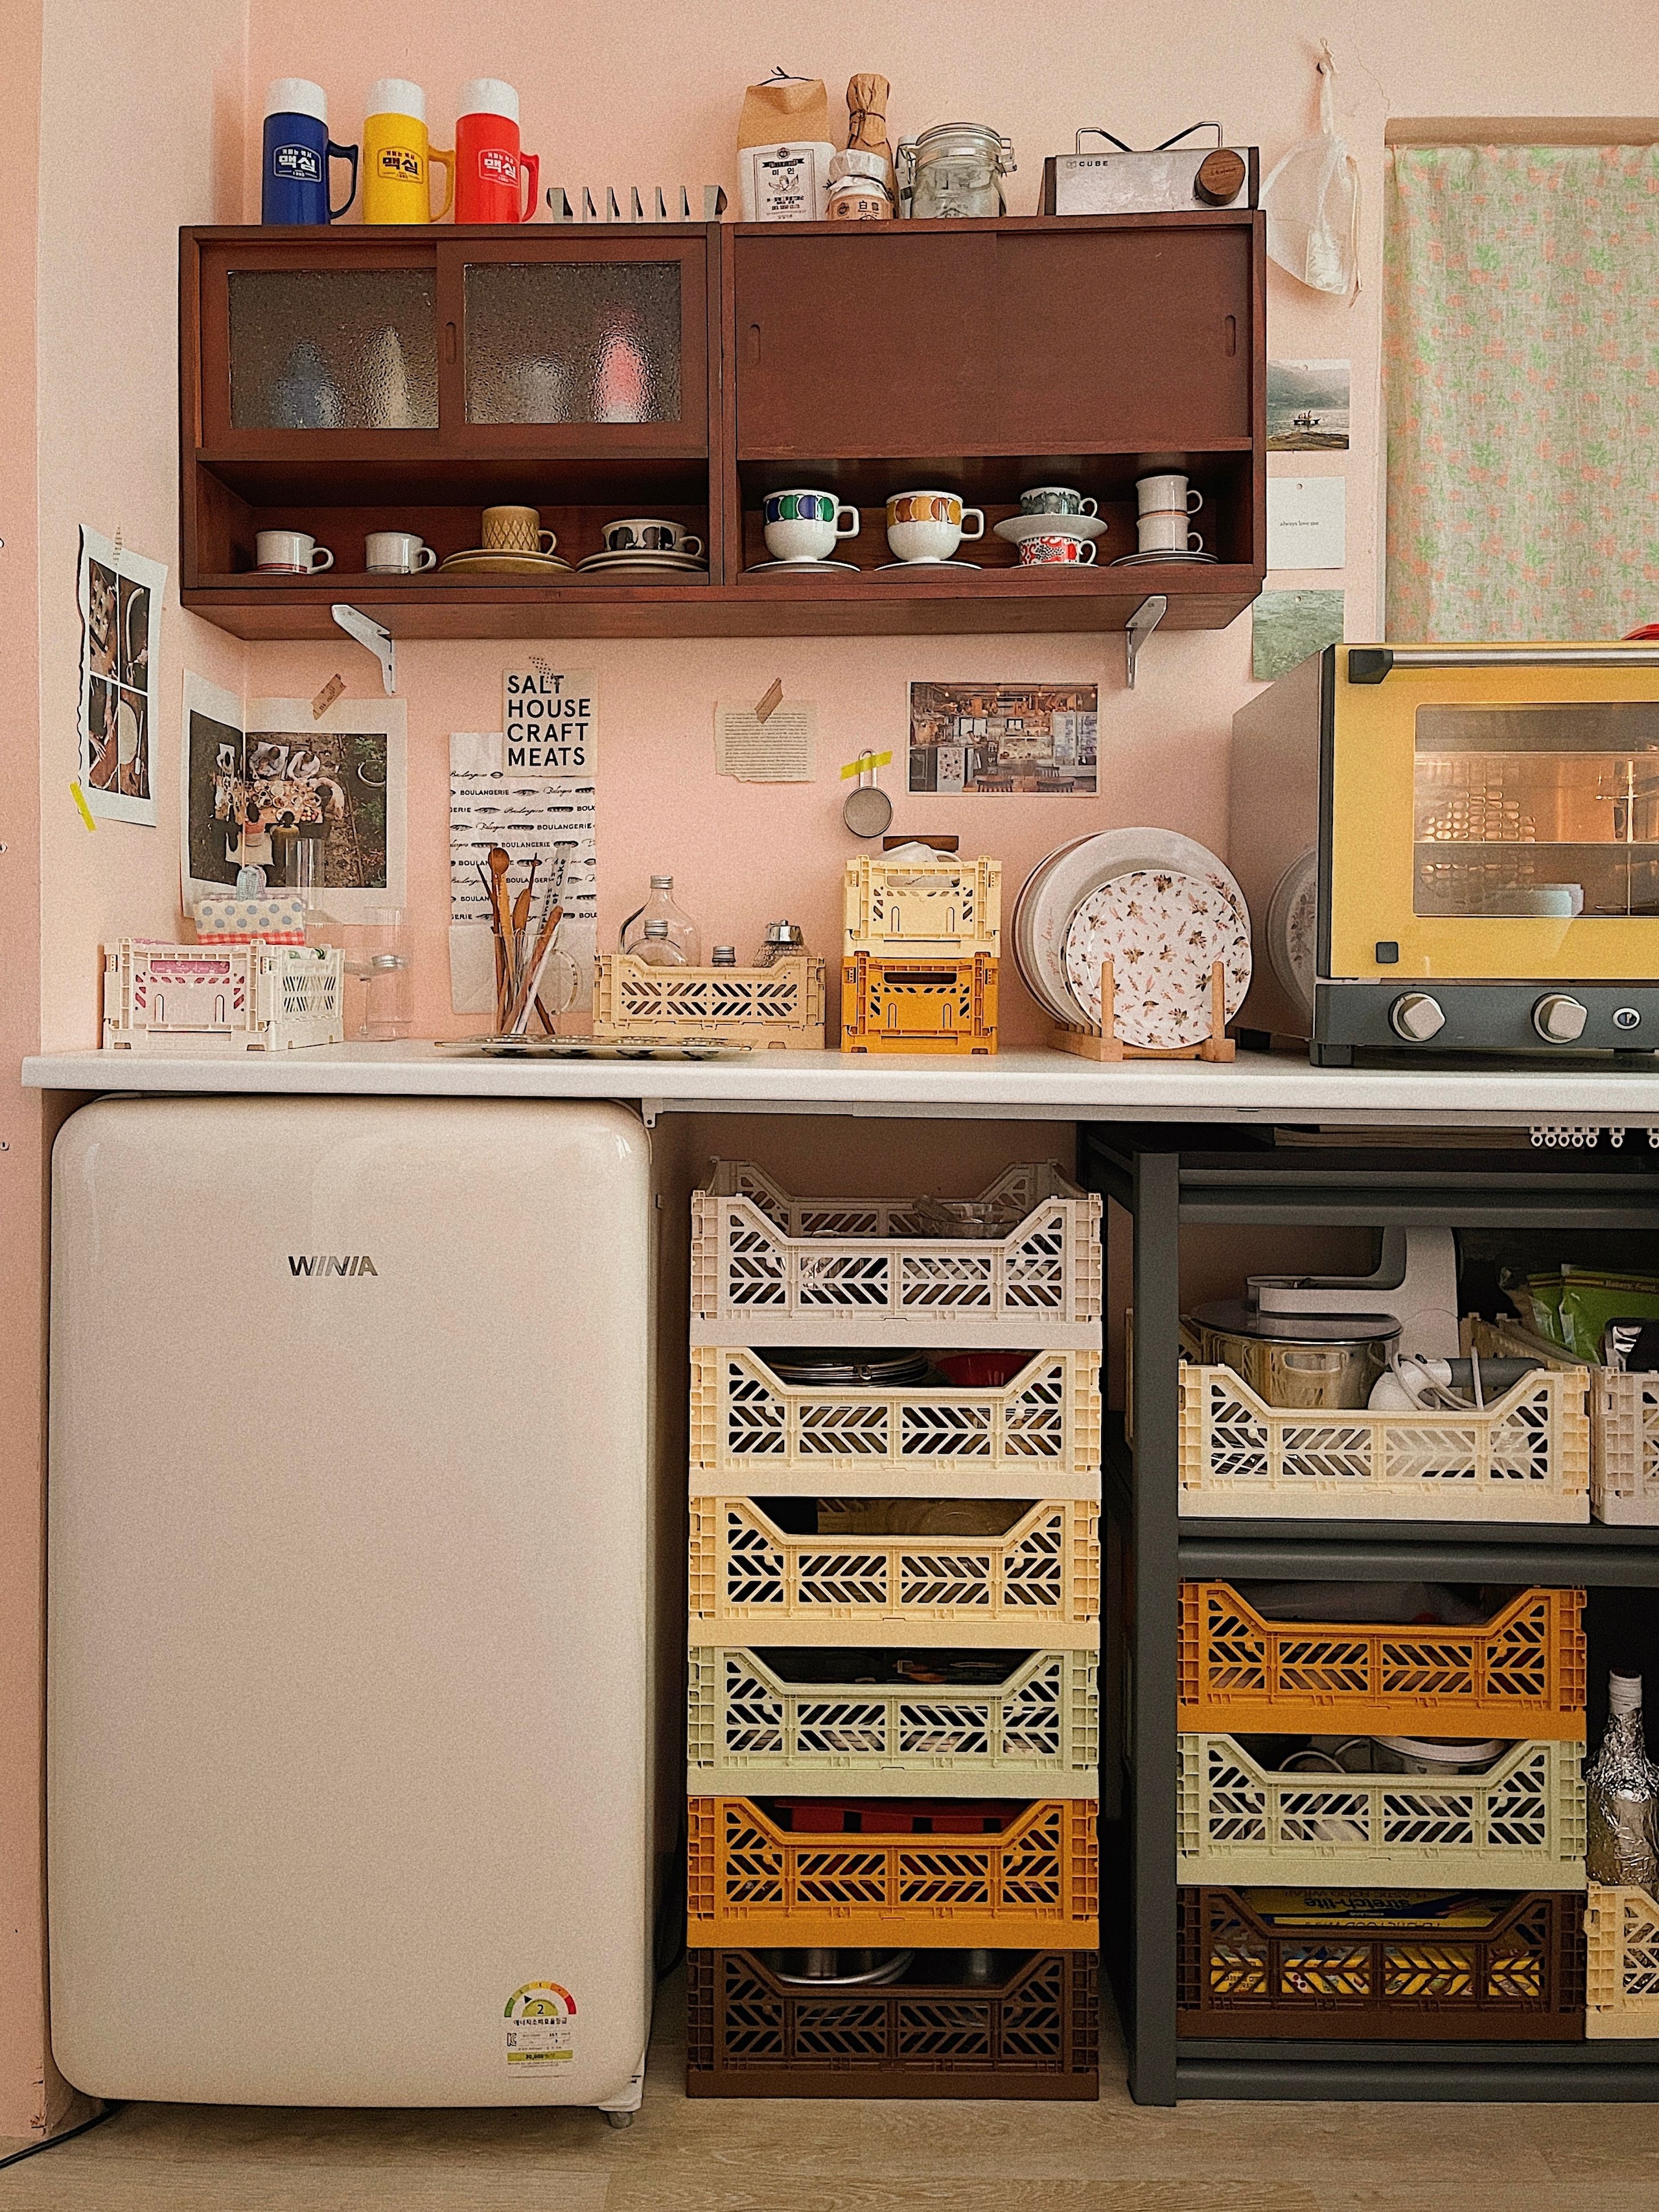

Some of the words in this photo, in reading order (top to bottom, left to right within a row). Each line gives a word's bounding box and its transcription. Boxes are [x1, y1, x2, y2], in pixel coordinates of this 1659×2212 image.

[279, 155, 317, 174] 맥심
[382, 157, 419, 175] 맥심
[484, 158, 517, 180] 맥심
[507, 675, 564, 694] SALT
[508, 698, 591, 718] HOUSE
[507, 723, 589, 742] CRAFT
[508, 747, 585, 767] MEATS
[556, 859, 566, 887] cake
[288, 1255, 378, 1276] WINIA
[1303, 1898, 1411, 1910] stretch-tite
[537, 2004, 544, 2014] 2
